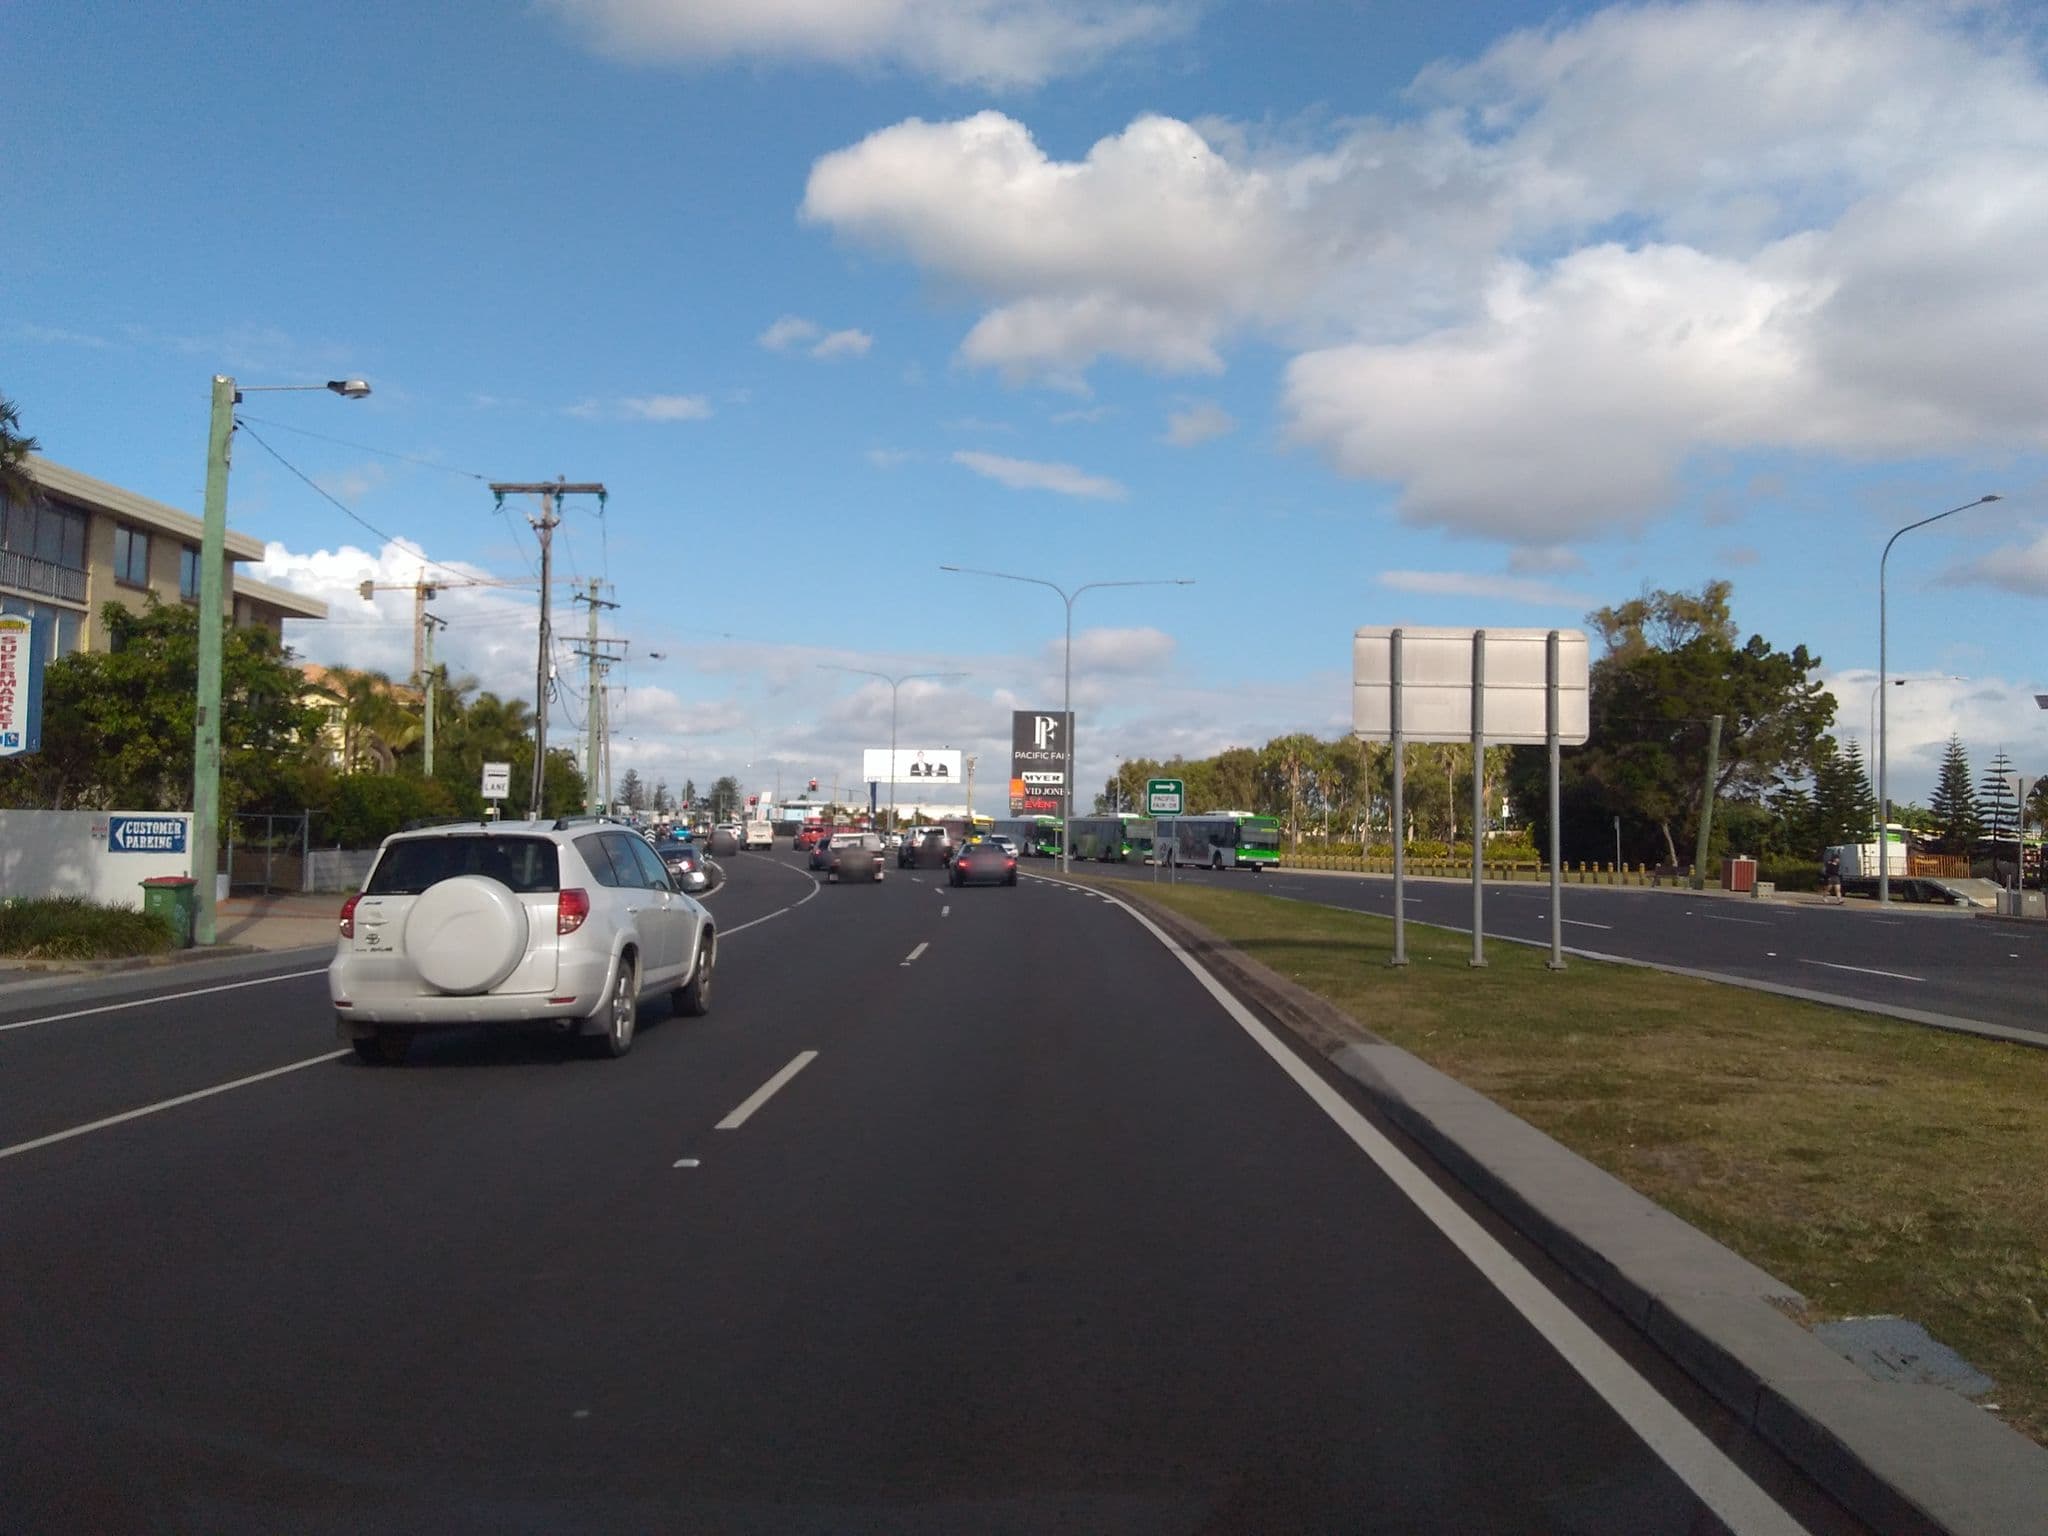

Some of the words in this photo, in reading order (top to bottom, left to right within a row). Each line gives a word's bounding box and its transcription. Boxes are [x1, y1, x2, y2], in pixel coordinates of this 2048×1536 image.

[0, 636, 17, 730] SUPERMARKET
[1015, 751, 1049, 760] PACIFIC
[485, 783, 506, 792] LANE
[1024, 787, 1042, 796] VID
[1024, 800, 1057, 808] EVENT
[126, 821, 182, 835] CUSTOMER
[125, 835, 173, 849] PARKING
